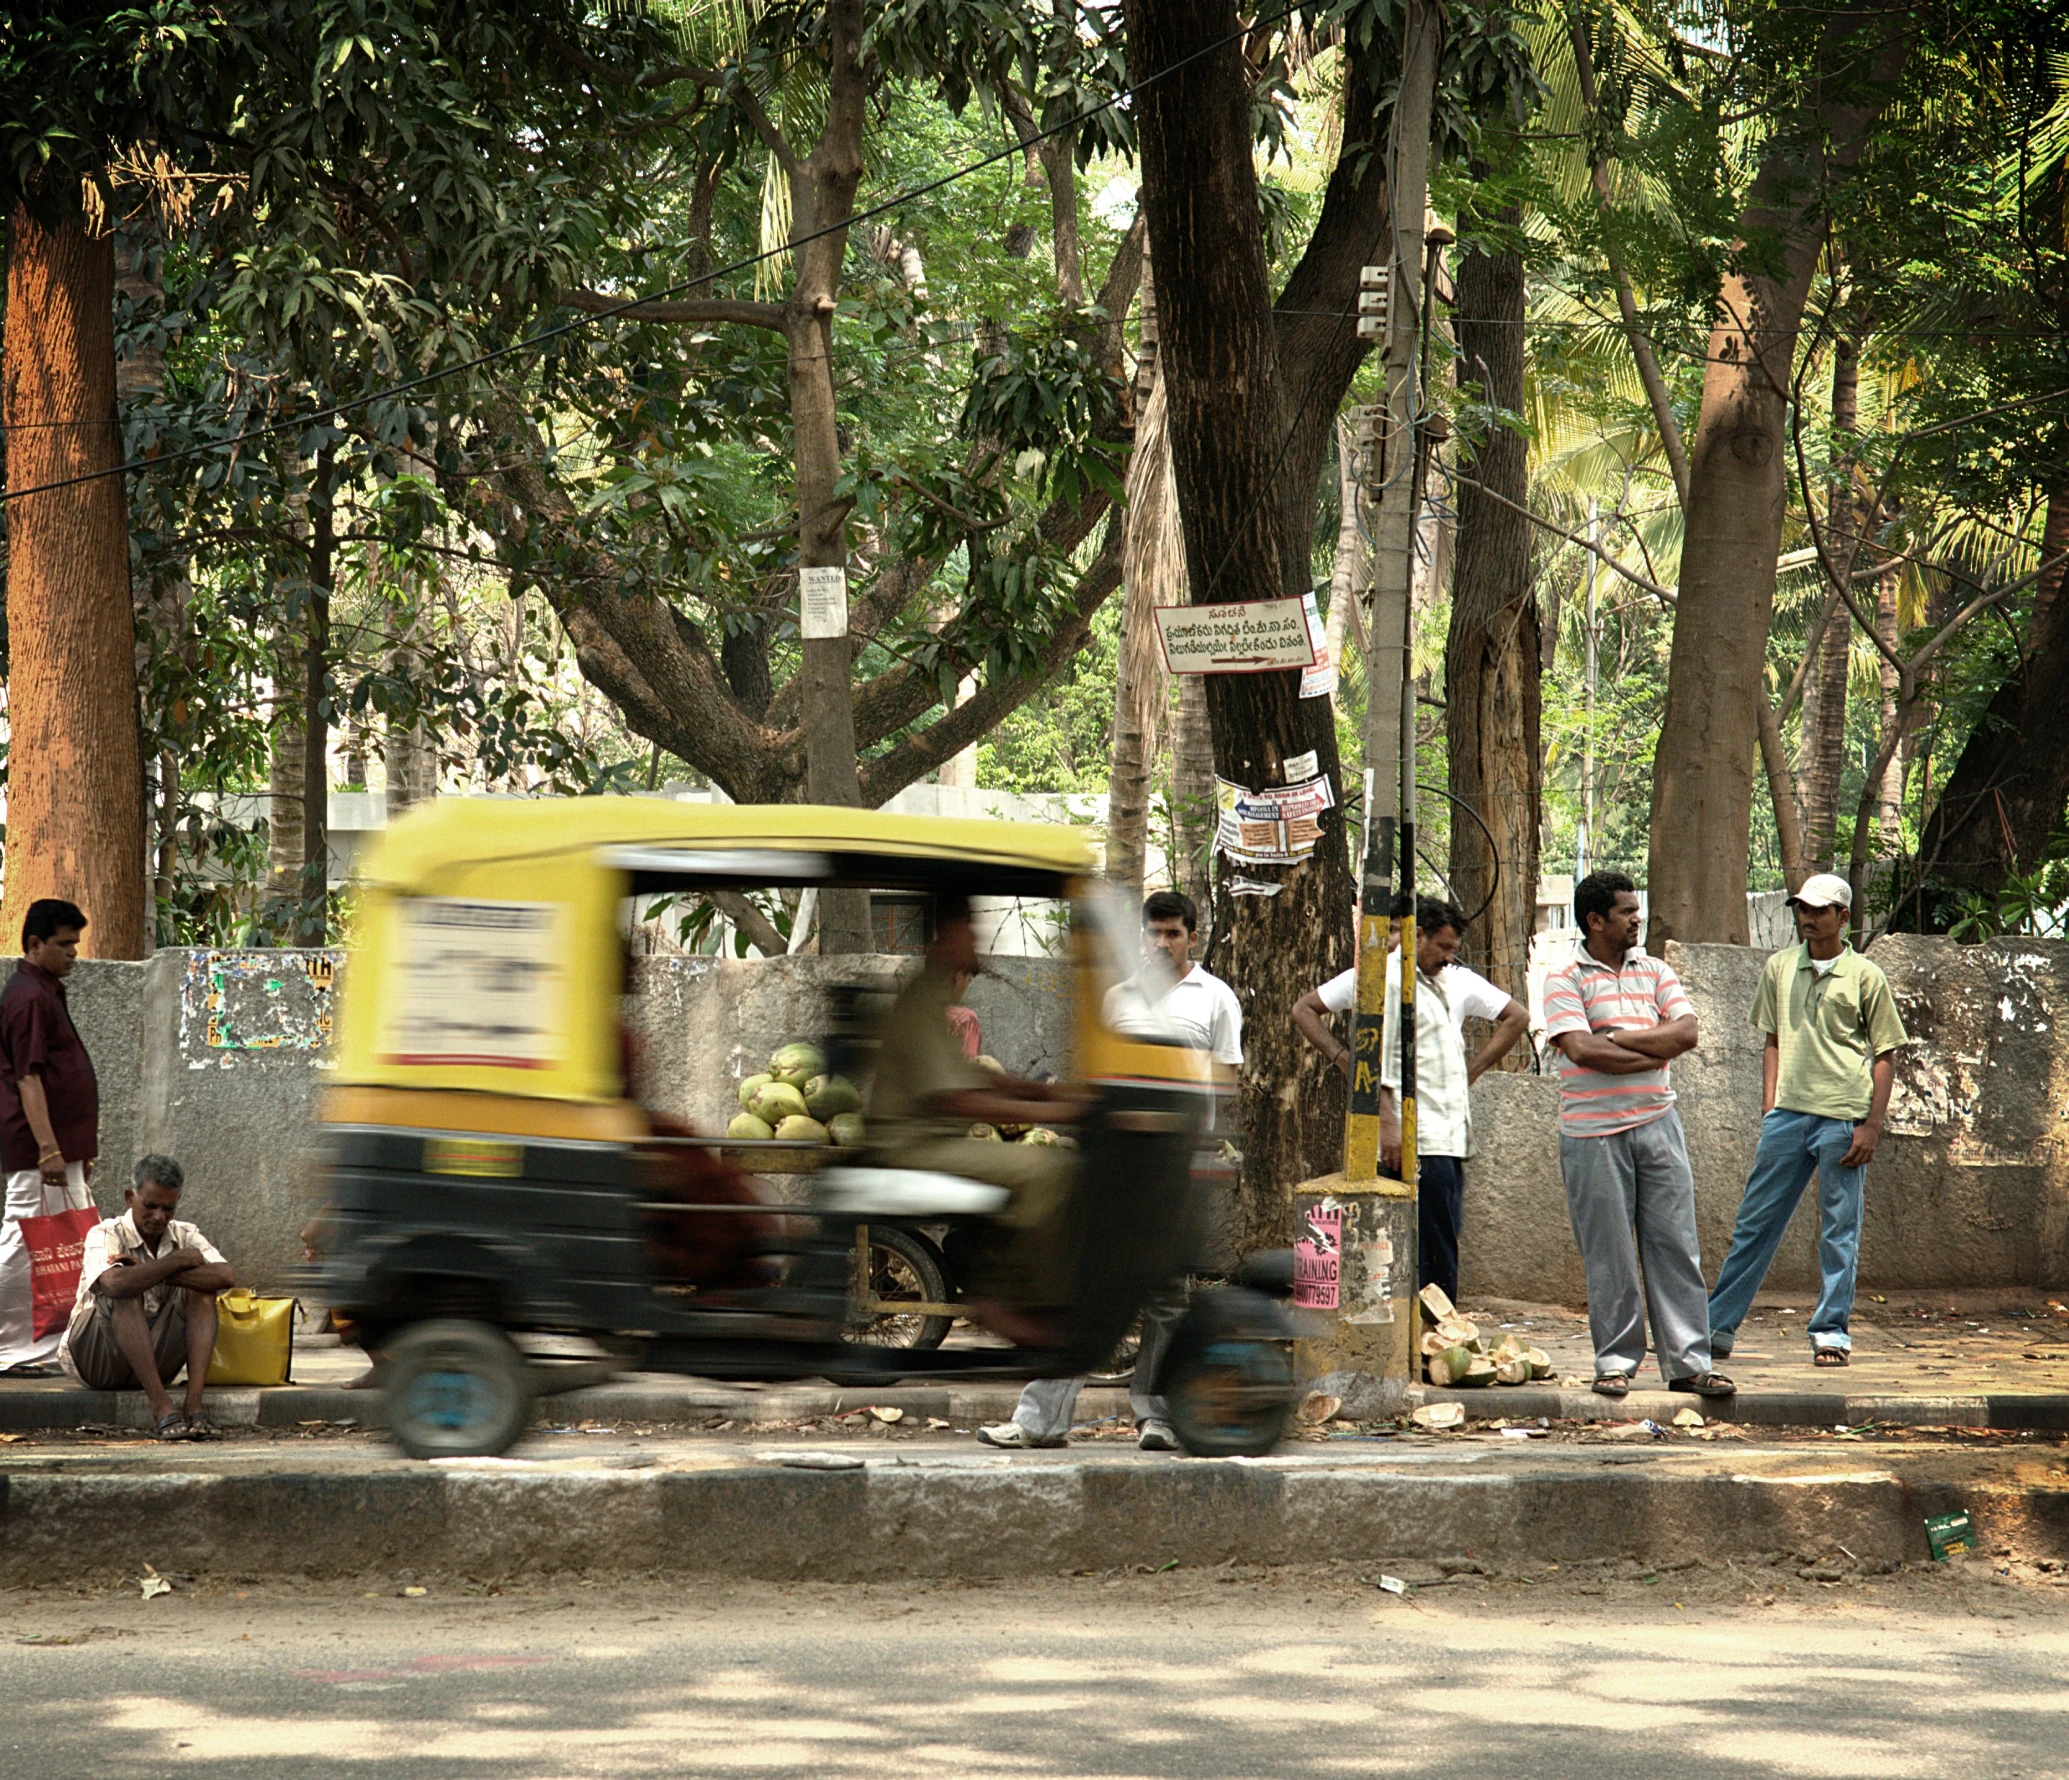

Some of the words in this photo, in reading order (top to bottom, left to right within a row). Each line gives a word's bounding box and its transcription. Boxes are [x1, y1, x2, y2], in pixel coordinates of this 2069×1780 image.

[808, 575, 842, 583] WANTED
[1208, 605, 1246, 620] ಸೂಚನೆ
[1296, 1257, 1337, 1282] TRAINING
